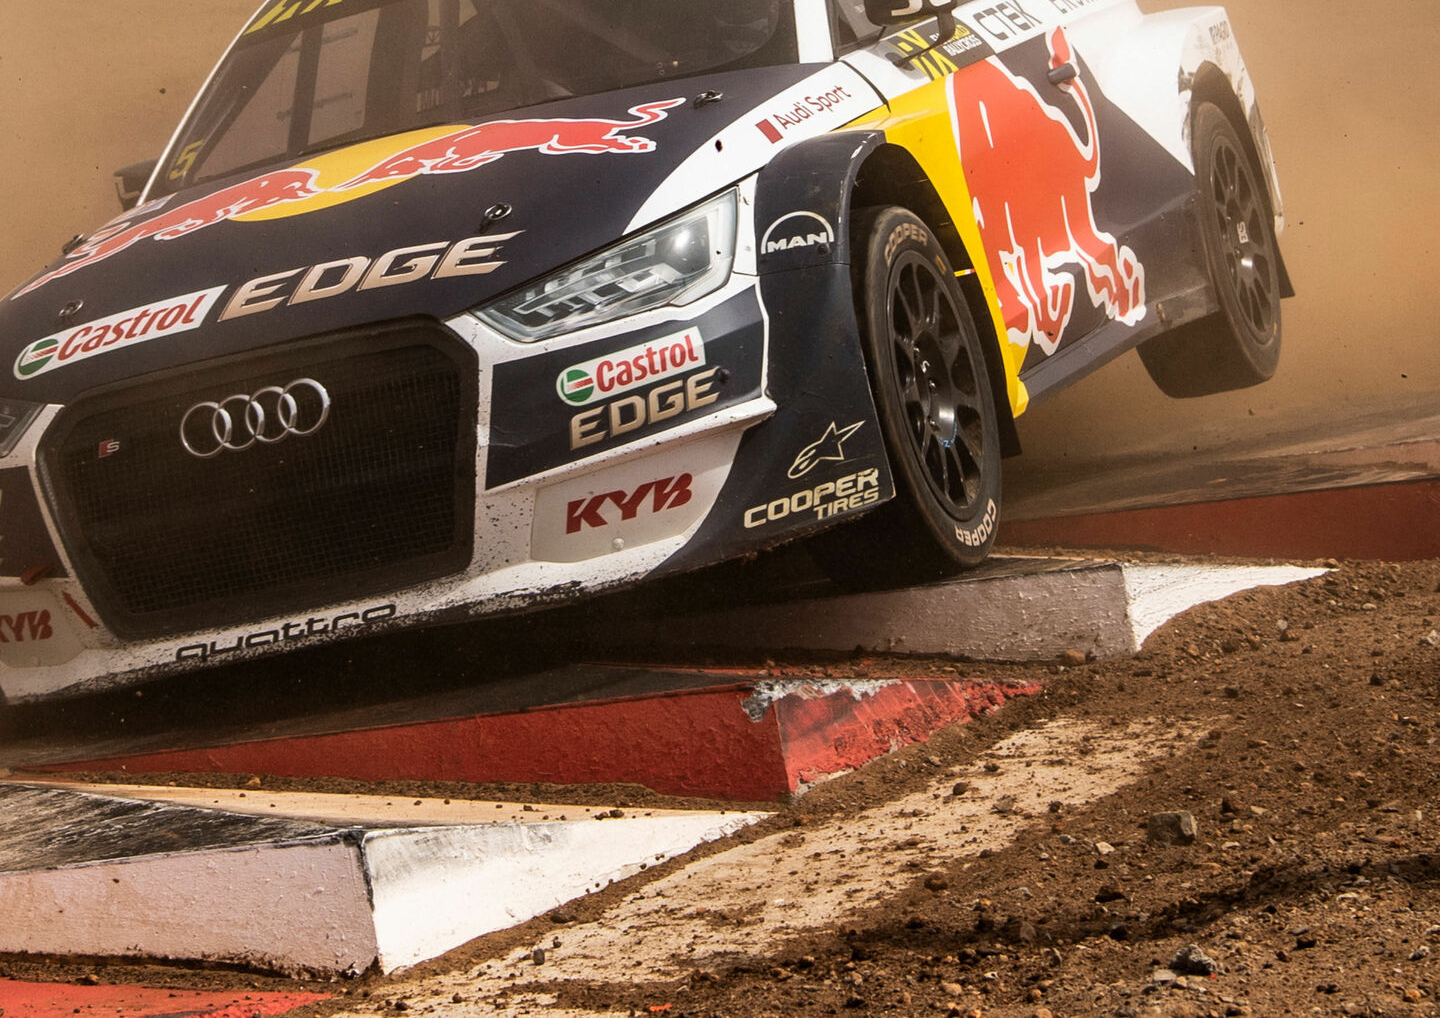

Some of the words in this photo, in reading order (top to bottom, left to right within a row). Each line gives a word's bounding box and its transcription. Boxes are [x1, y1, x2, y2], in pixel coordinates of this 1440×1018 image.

[772, 101, 815, 130] Audi
[804, 85, 852, 112] Sport
[169, 138, 205, 180] 5
[766, 231, 828, 254] MAN
[884, 222, 929, 268] COOPER
[58, 293, 209, 361] Castrol
[217, 229, 526, 323] EDGE
[595, 334, 699, 393] Castrol
[570, 365, 721, 452] EDGE
[565, 472, 694, 535] KYB
[743, 467, 879, 529] COOPER
[813, 486, 880, 521] TIRES
[954, 497, 997, 547] COOPER
[175, 603, 397, 663] quattro
